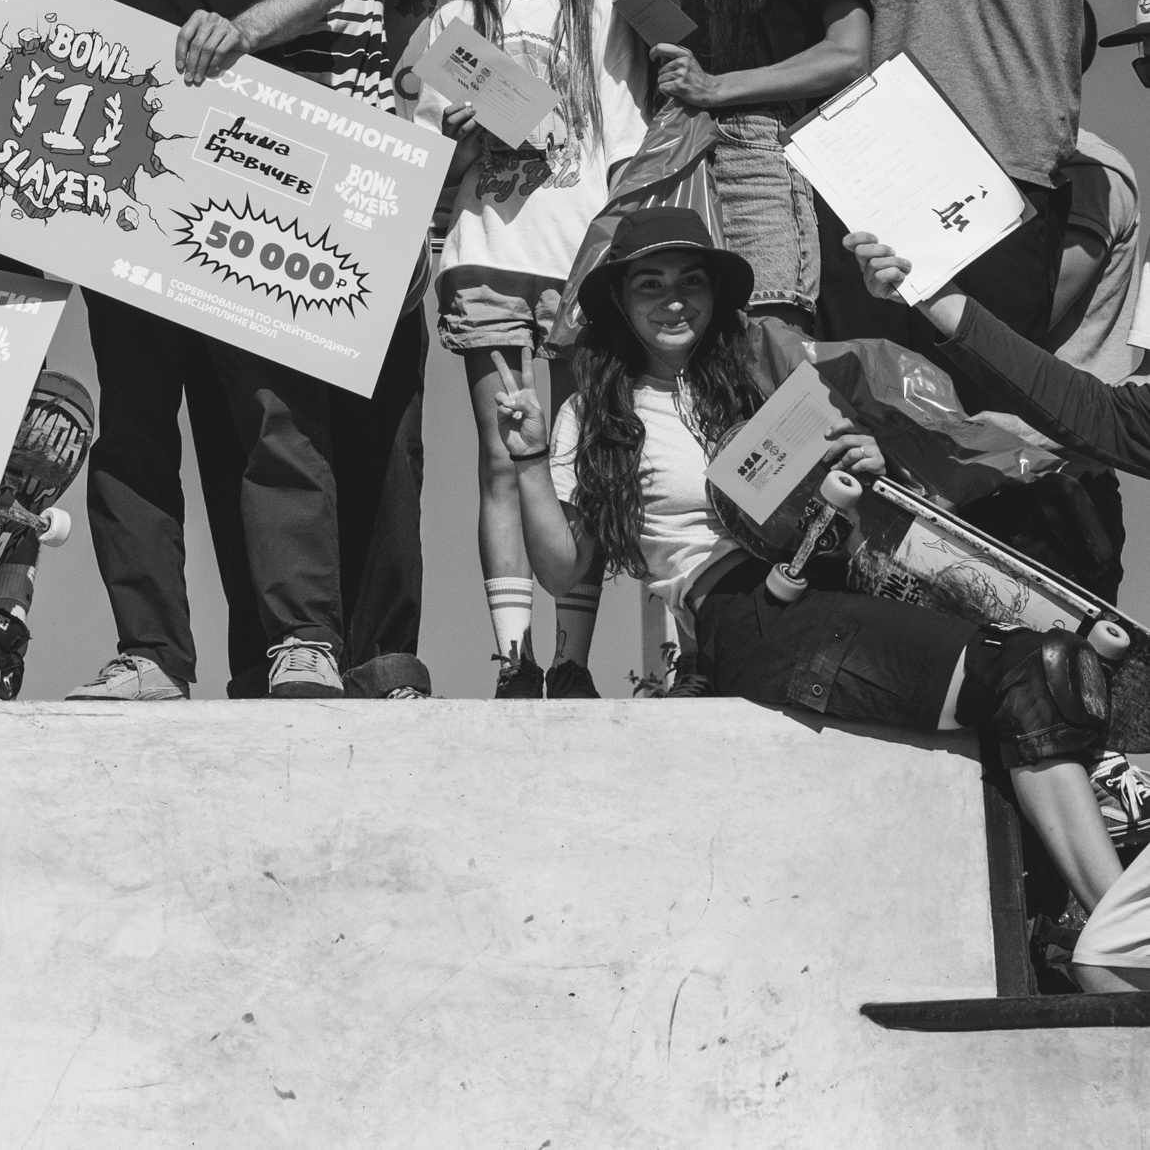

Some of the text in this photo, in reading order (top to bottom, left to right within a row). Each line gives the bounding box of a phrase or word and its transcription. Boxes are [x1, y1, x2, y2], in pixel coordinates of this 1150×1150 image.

[49, 24, 132, 81] BOWL
[42, 83, 94, 152] 1
[218, 117, 291, 156] Дима
[252, 82, 298, 115] ЖК
[300, 100, 429, 169] ТРИЛОГИЯ
[335, 181, 399, 217] SLAYERS
[345, 164, 399, 201] BOWL
[205, 220, 254, 258] 50
[259, 242, 335, 290] 000
[166, 288, 278, 340] В ДИСЦИПЛИНЕ БОУЛ
[169, 278, 361, 360] СОРЕВНОВАНИЯ ПО СКЕЙТБОРДИНГУ
